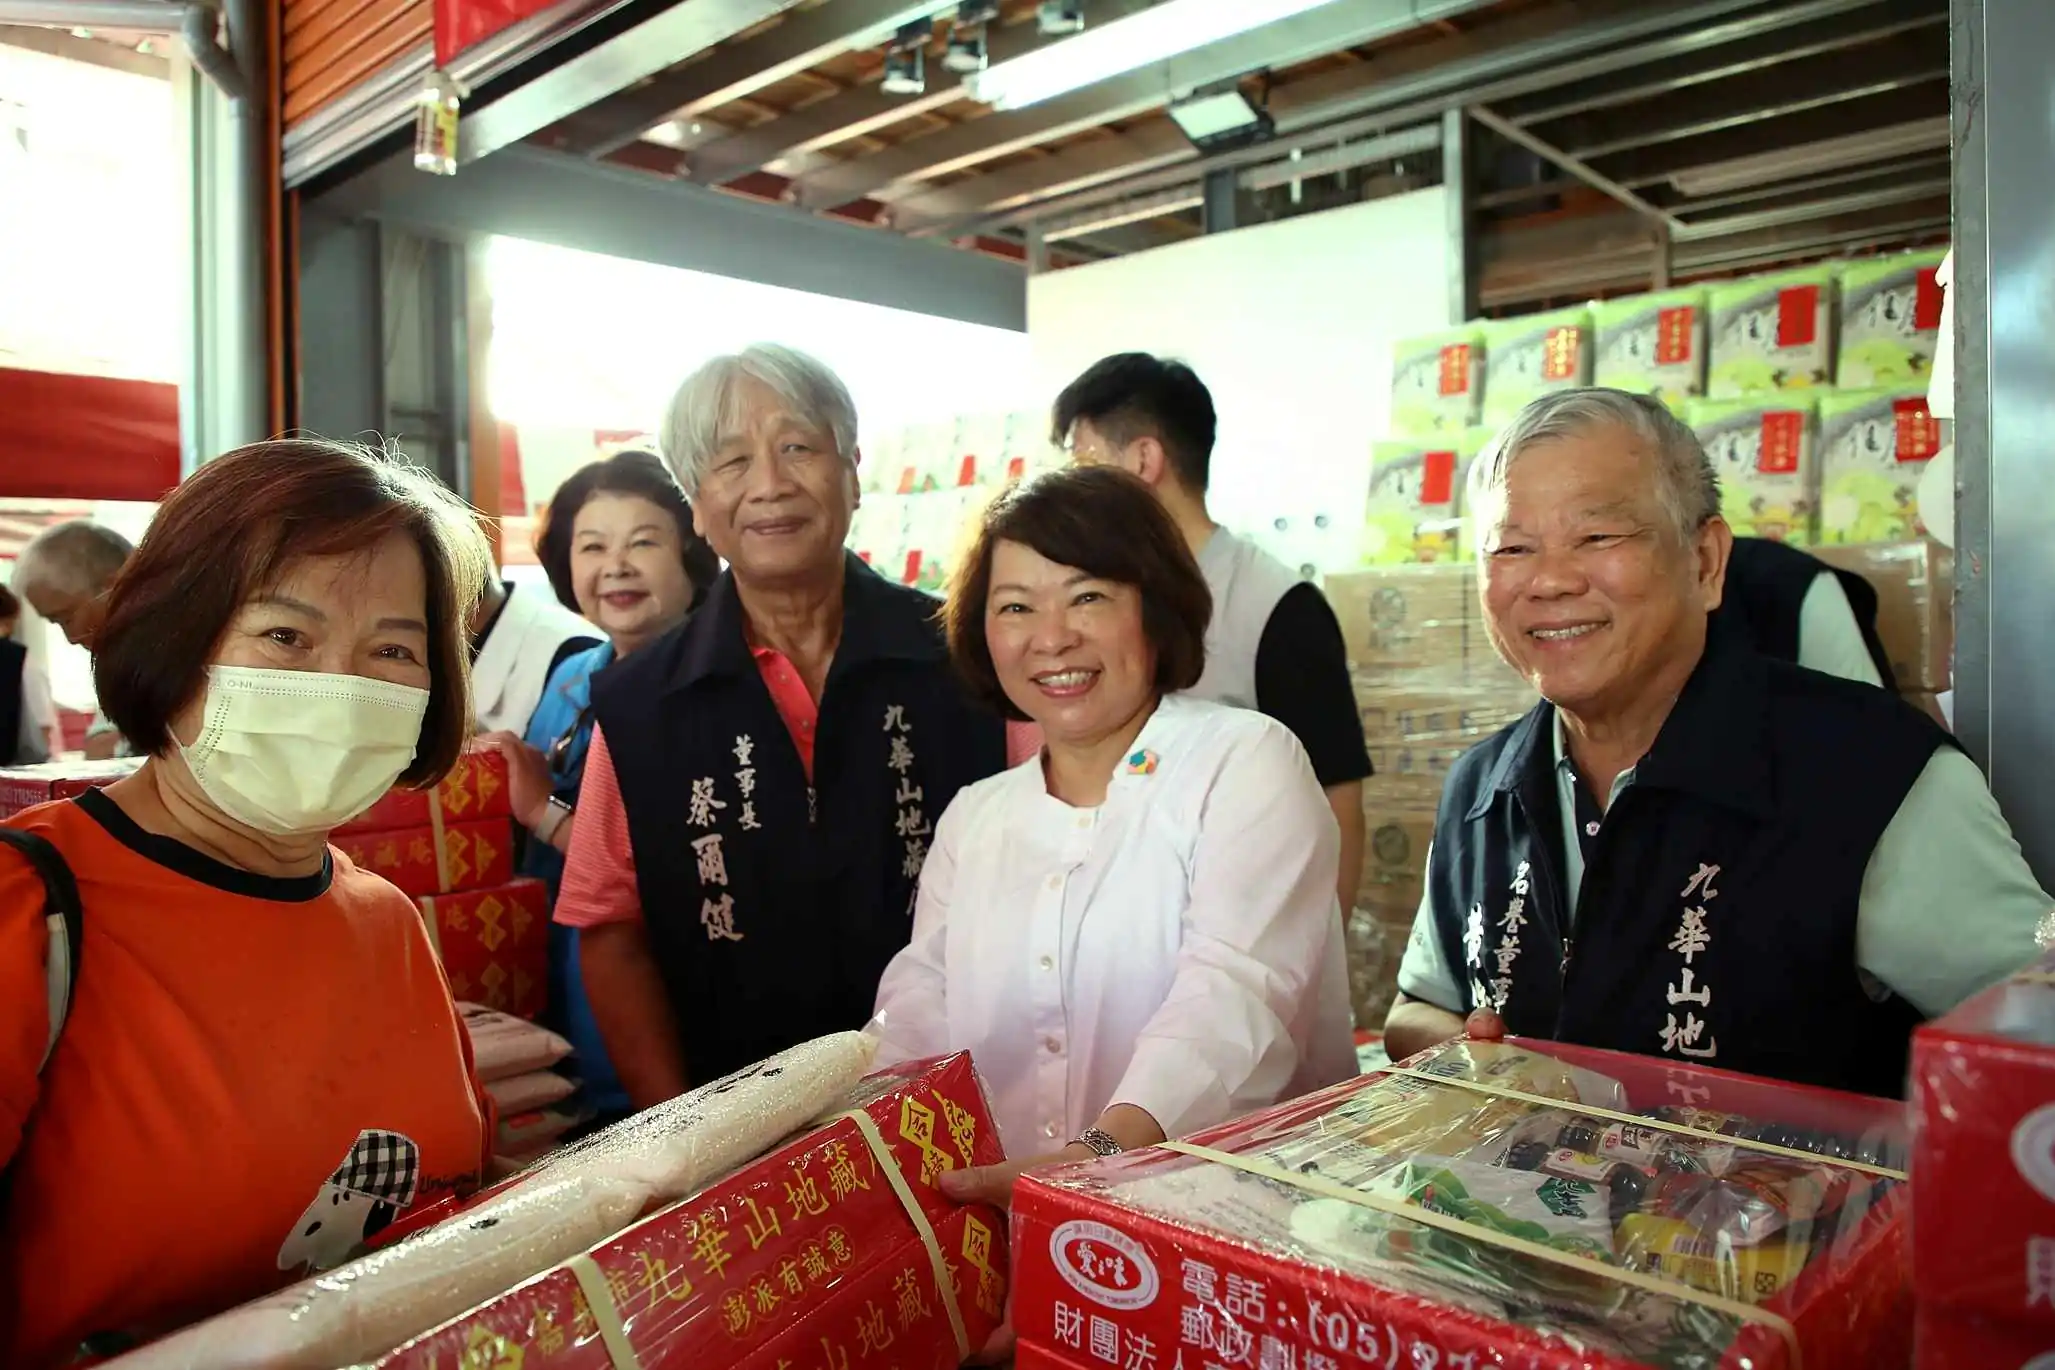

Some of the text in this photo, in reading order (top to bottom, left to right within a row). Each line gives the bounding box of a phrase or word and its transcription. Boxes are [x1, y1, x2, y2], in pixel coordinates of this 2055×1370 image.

[686, 776, 745, 942] 蔡爾健
[731, 734, 763, 831] 董事長
[882, 704, 932, 916] 九華山地藏
[1658, 862, 1721, 1058] 九華山地
[723, 1229, 853, 1335] 澎派有誠意
